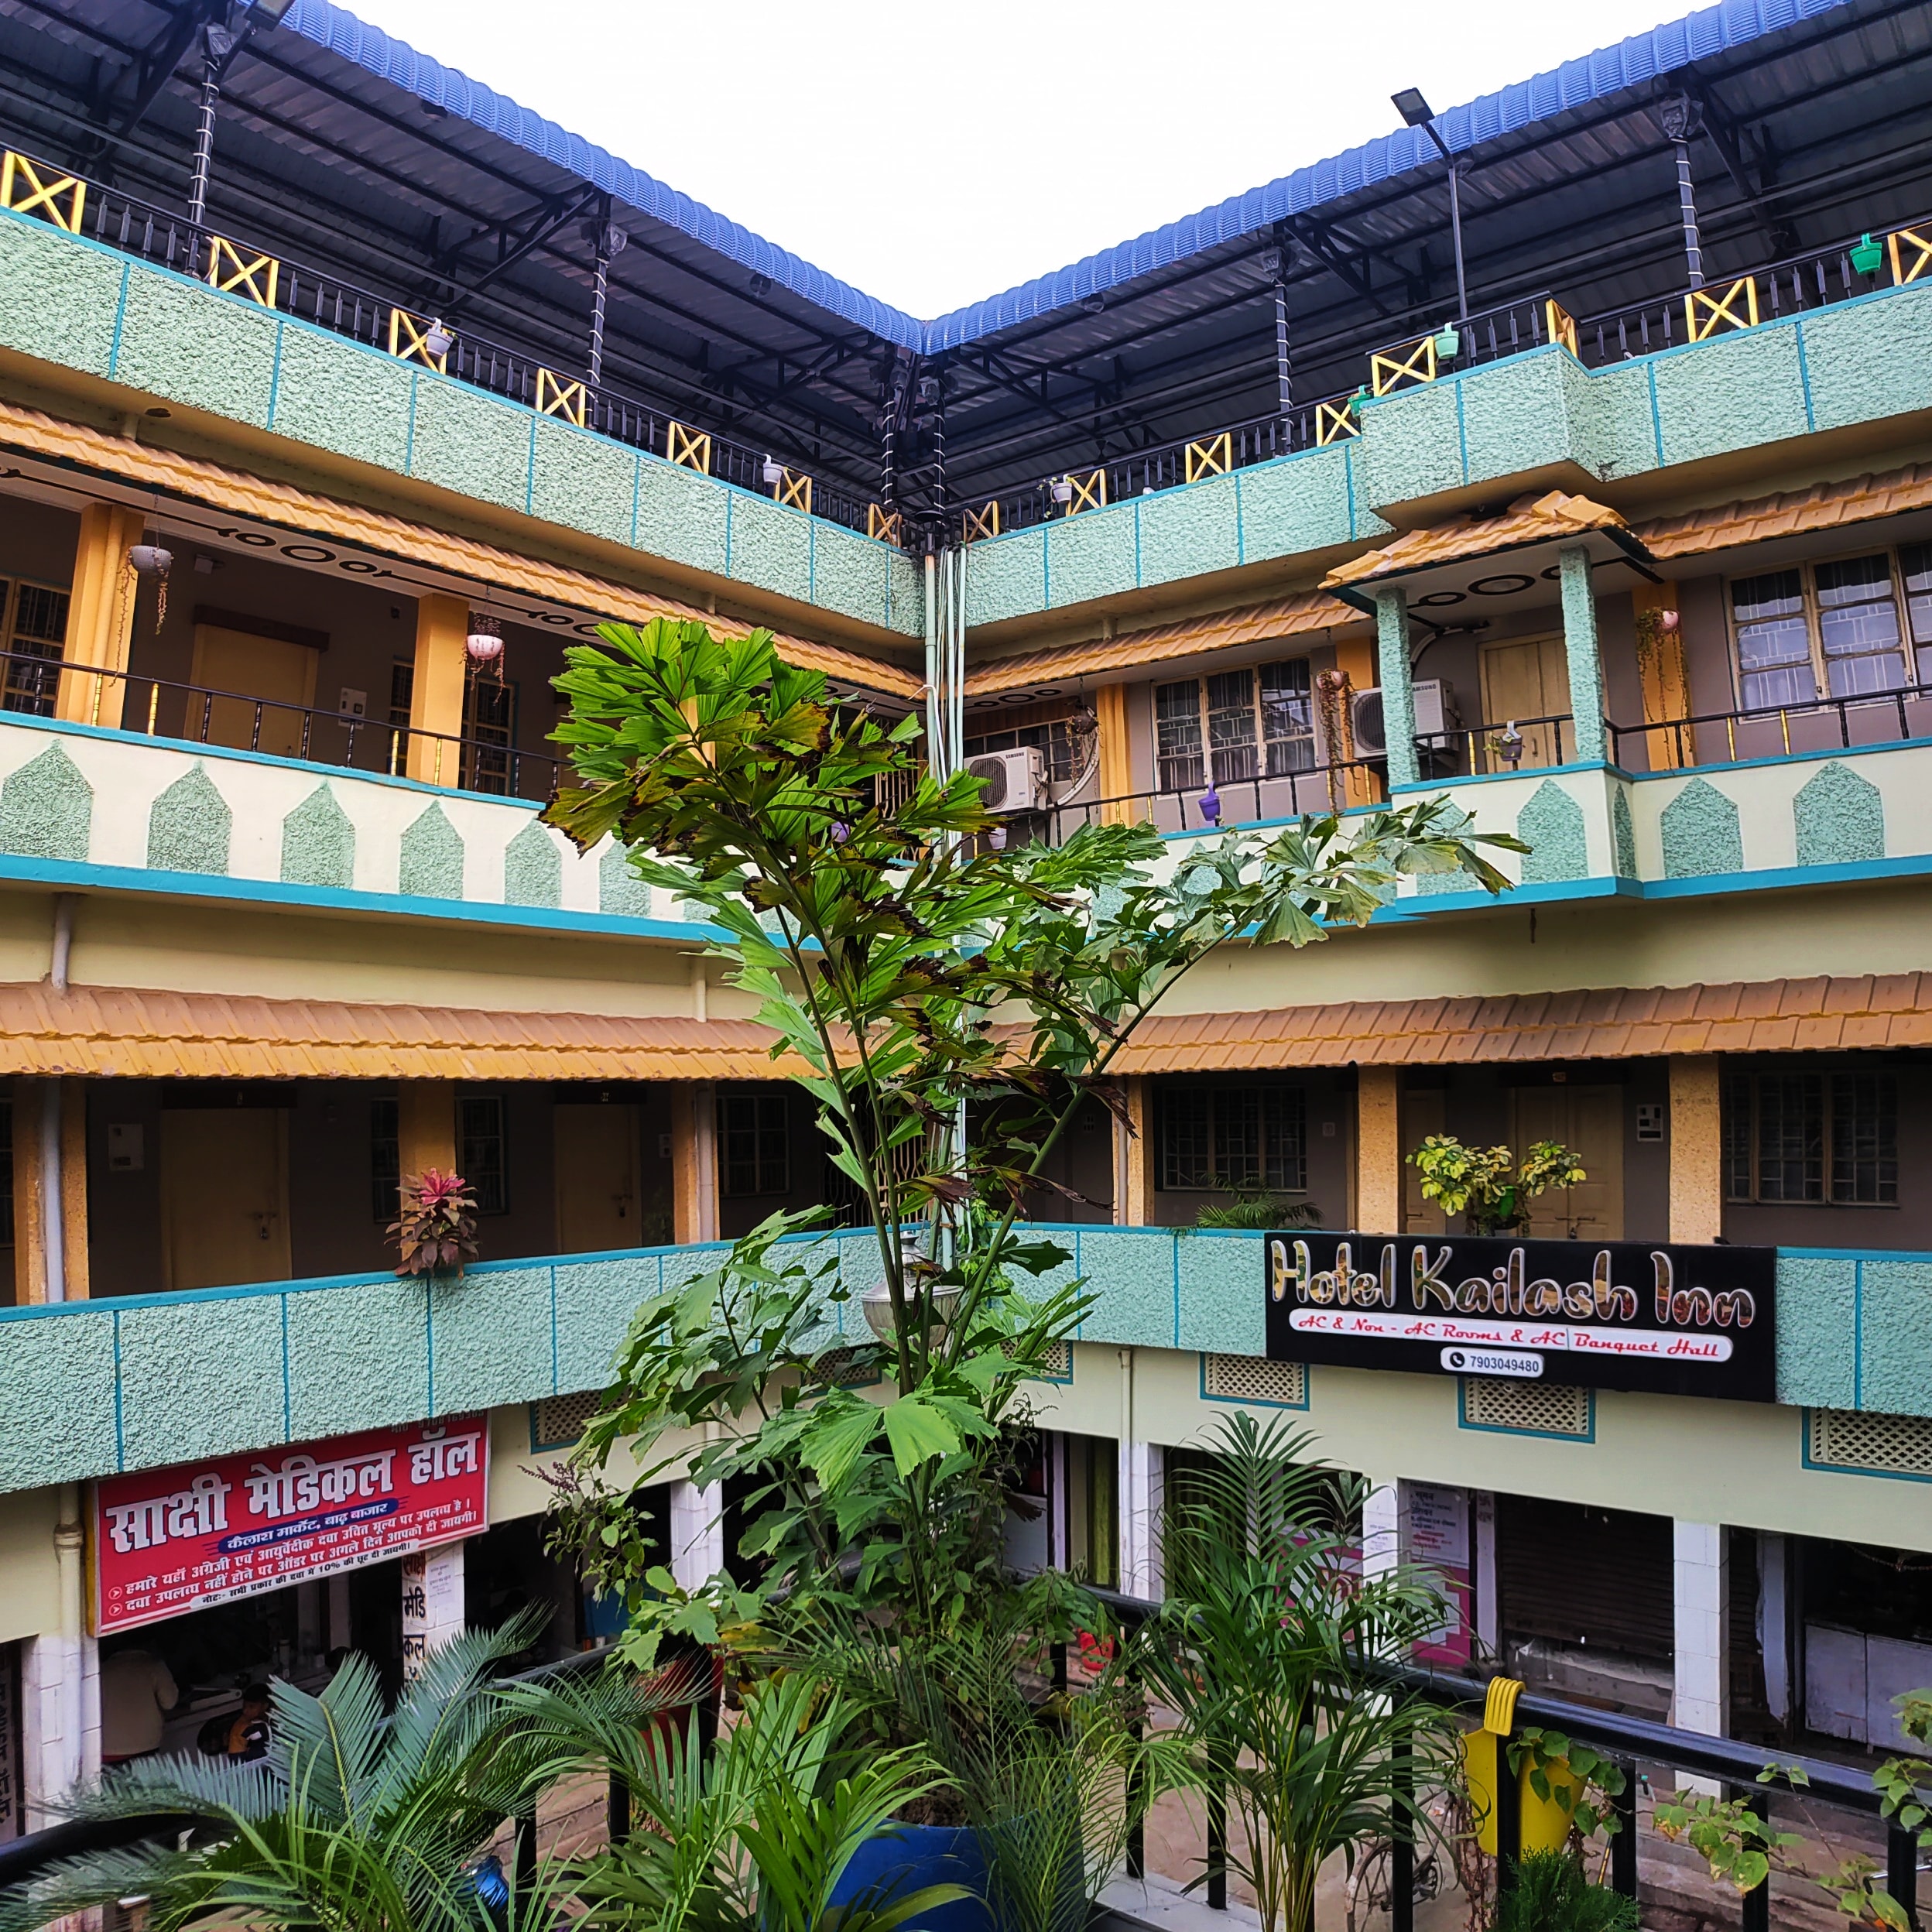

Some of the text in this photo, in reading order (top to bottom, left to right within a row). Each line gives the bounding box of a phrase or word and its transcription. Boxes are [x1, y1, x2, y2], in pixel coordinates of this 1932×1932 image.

[1411, 683, 1437, 693] AMSUNG
[1270, 1240, 1756, 1328] Hotel Kailash Inn
[1298, 1315, 1327, 1328] AC
[1332, 1317, 1345, 1330] &
[1350, 1318, 1384, 1333] Non
[1404, 1322, 1436, 1337] AC
[1441, 1324, 1502, 1341] Rooms
[1510, 1328, 1525, 1343] &
[1530, 1331, 1565, 1346] AC
[1574, 1333, 1660, 1353] Banquet
[1667, 1338, 1719, 1357] Hall
[1470, 1355, 1540, 1373] 7903049480
[105, 1426, 481, 1553] साक्षी मेडिकल हॉल
[227, 1530, 274, 1550] कैलाश
[350, 1502, 388, 1519] बाजार
[125, 1576, 158, 1595] हमारे
[234, 1550, 254, 1567] एवं
[317, 1531, 338, 1545] दवा
[342, 1524, 369, 1540] उचित
[372, 1516, 396, 1535] मूल्य
[399, 1512, 413, 1524] पर
[125, 1595, 152, 1612] दवा
[204, 1572, 228, 1591] नहीं
[231, 1566, 254, 1584] होने
[257, 1563, 274, 1577] पर
[310, 1550, 325, 1563] पर
[328, 1540, 360, 1558] अगले
[363, 1534, 383, 1550] दिन
[386, 1524, 423, 1543] आपको
[426, 1519, 437, 1533] दी
[250, 1579, 272, 1591] प्रकार
[275, 1574, 287, 1584] की
[290, 1571, 305, 1581] दवा
[318, 1560, 342, 1574] 10%
[343, 1557, 355, 1567] की
[372, 1549, 380, 1559] दी
[403, 1633, 426, 1661] कल
